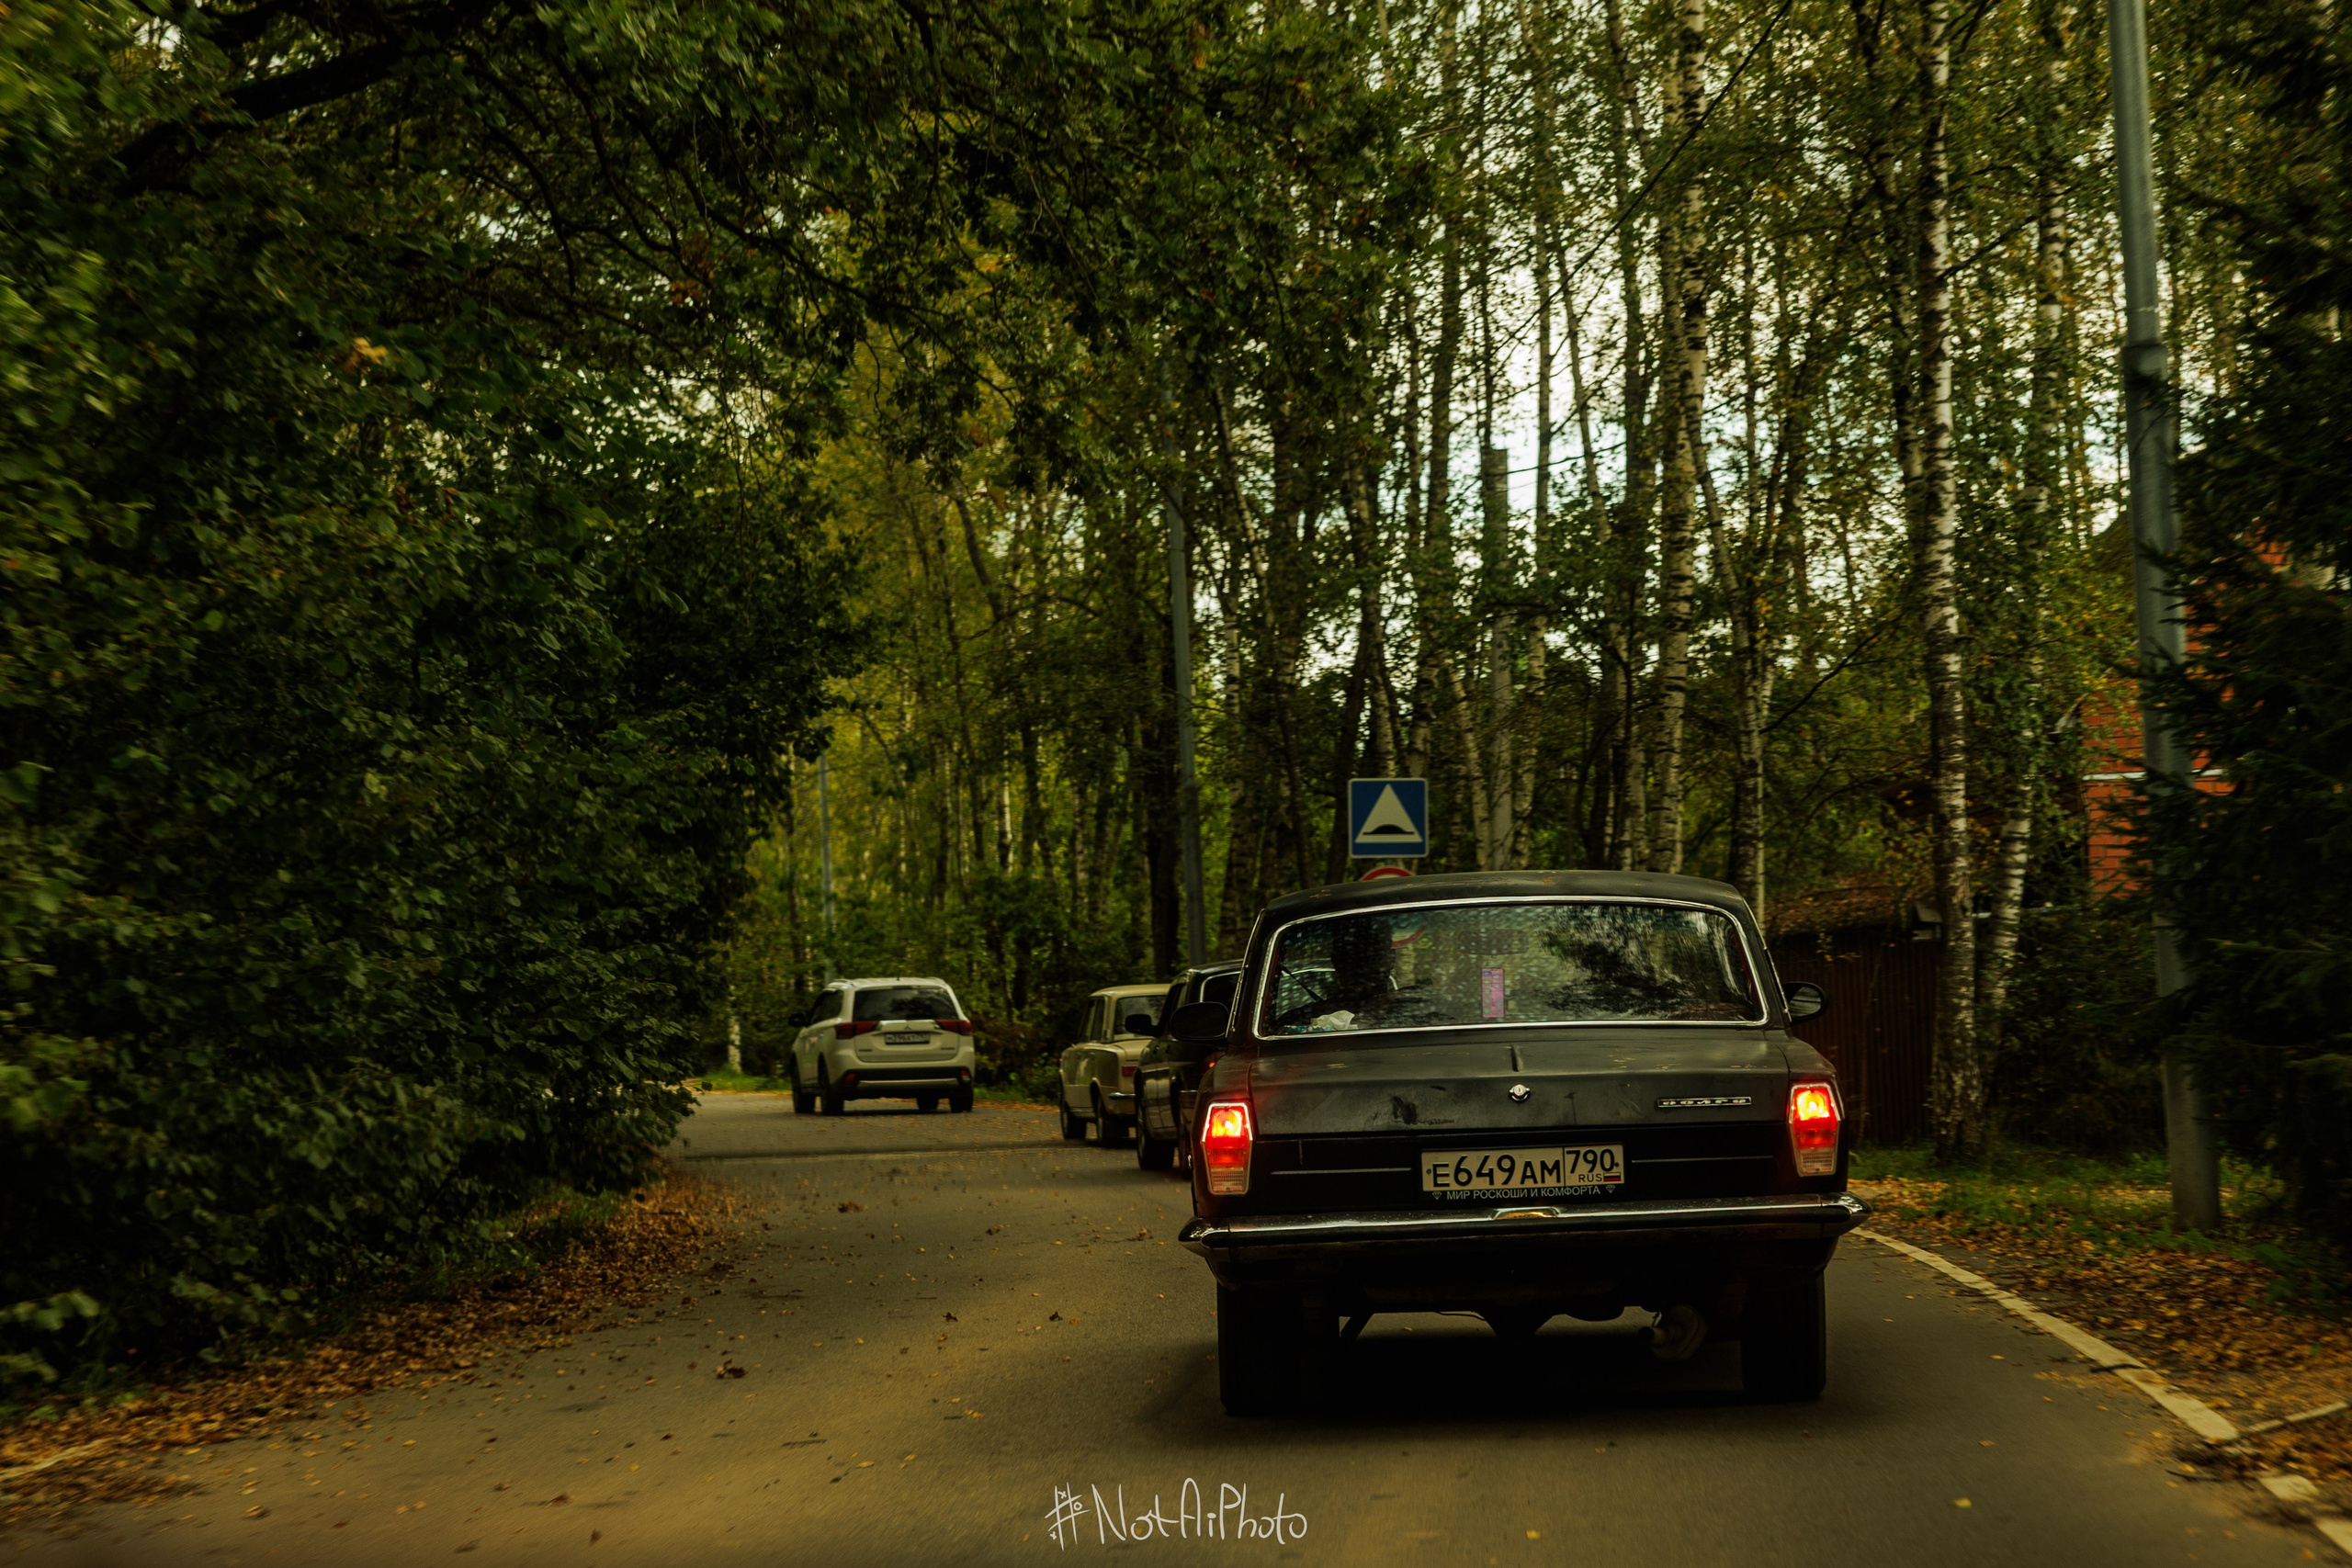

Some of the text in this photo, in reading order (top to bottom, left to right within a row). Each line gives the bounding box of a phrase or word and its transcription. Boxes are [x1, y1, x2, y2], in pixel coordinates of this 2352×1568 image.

[1432, 1148, 1615, 1188] Е649АМ 790
[1577, 1172, 1603, 1183] RUS
[1446, 1185, 1601, 1201] МИР РОСКОШИ И КОМФОРТА
